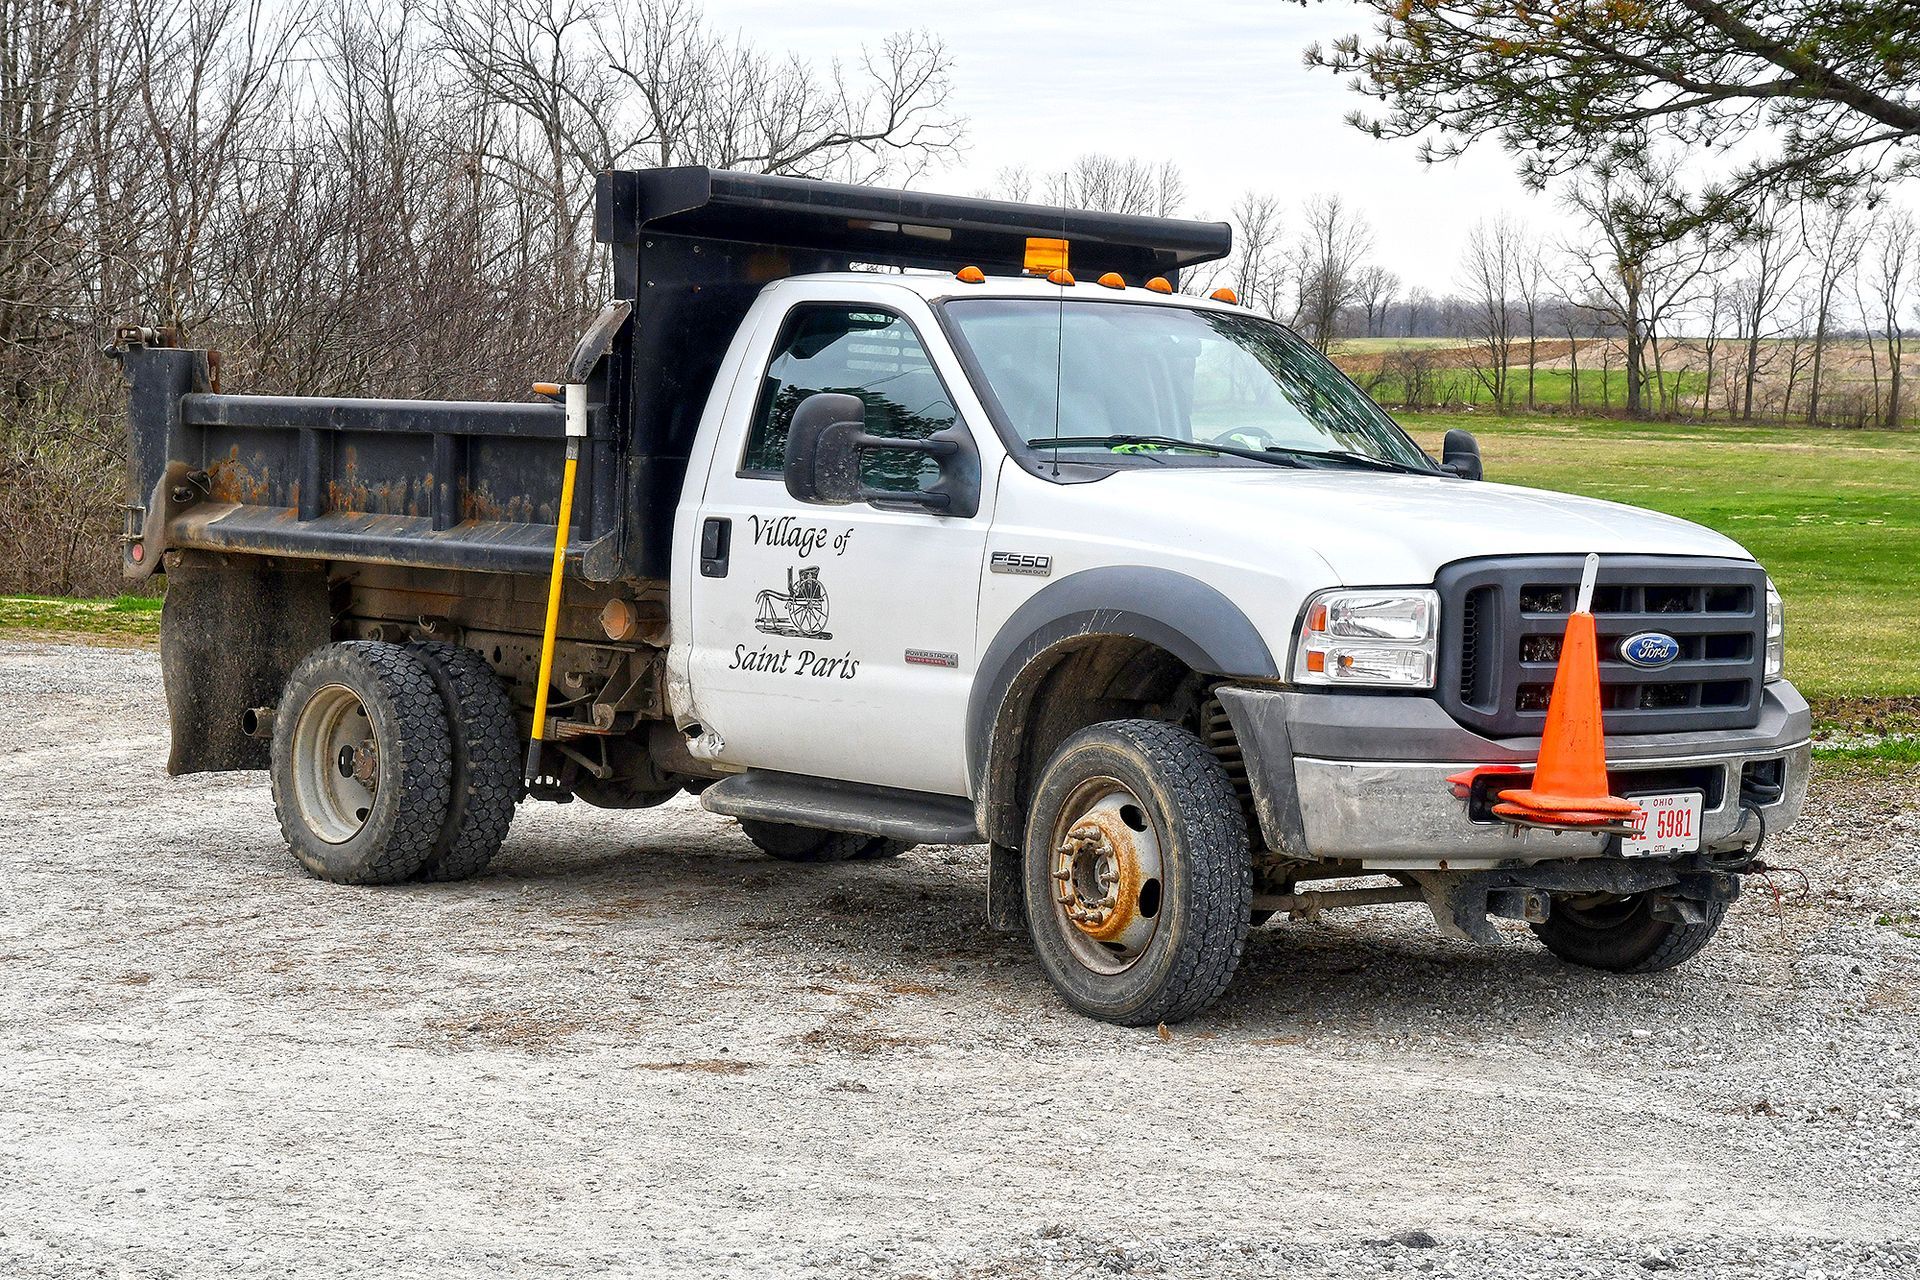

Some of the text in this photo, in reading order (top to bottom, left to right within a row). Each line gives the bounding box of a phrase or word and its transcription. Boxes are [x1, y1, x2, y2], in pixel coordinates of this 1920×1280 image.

[747, 514, 854, 558] Village of
[728, 643, 860, 680] Saint Paris
[1638, 638, 1670, 659] Ford
[1652, 797, 1673, 807] OHIO
[1656, 808, 1692, 839] 5981
[1653, 844, 1666, 853] CITY
